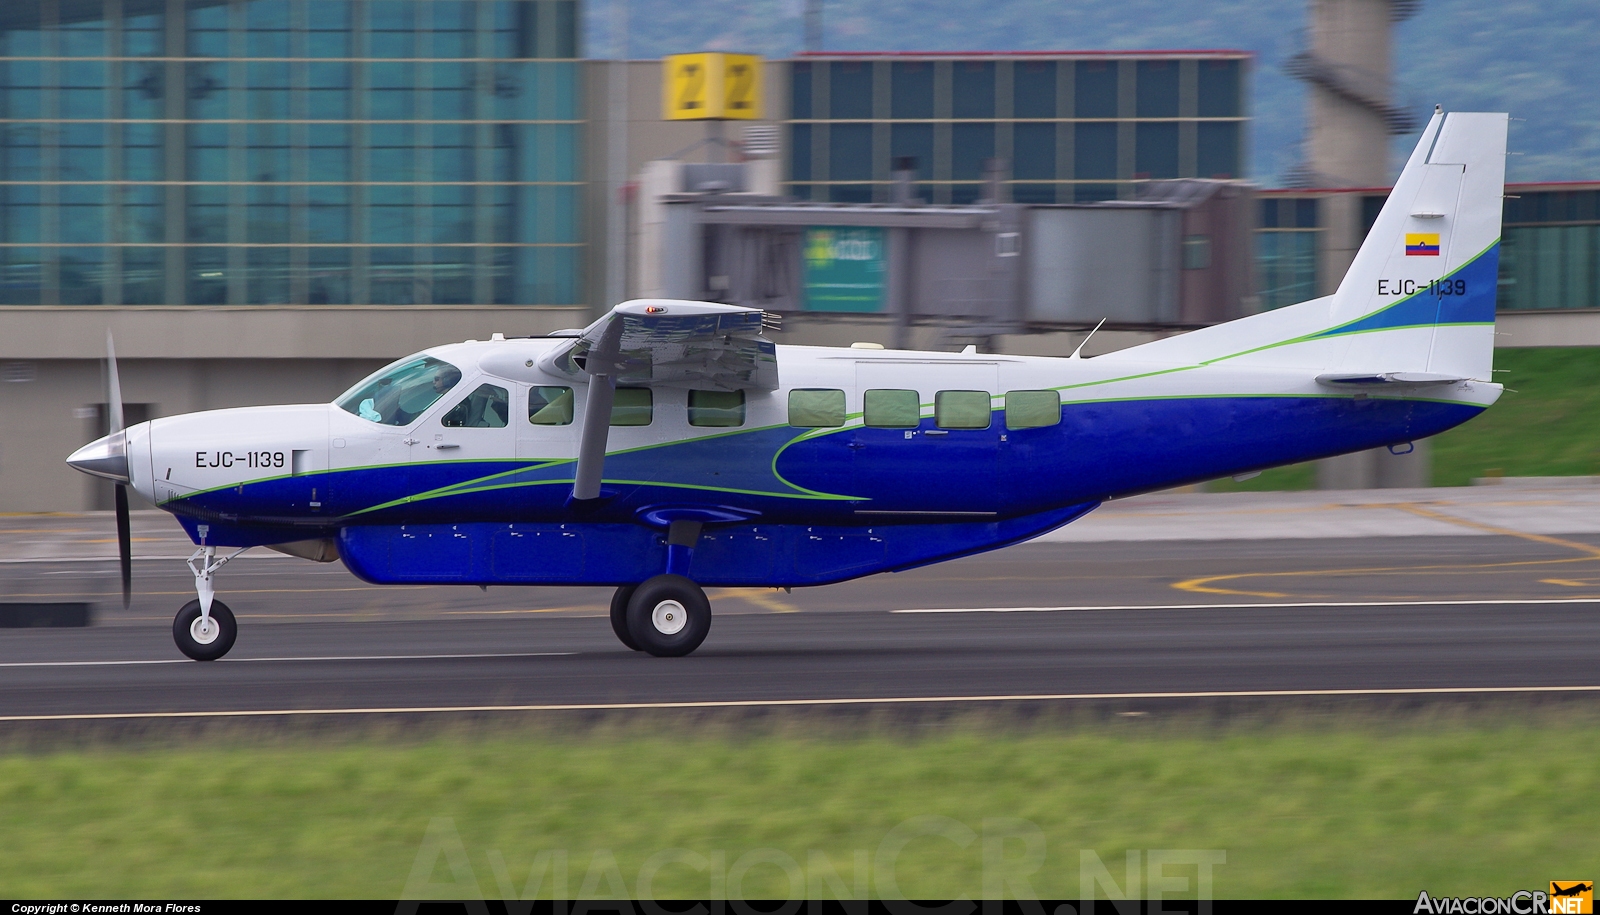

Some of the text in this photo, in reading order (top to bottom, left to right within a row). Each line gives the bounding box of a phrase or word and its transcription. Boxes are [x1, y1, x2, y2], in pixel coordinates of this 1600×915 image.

[676, 64, 705, 110] 2
[725, 64, 756, 110] 2
[1377, 279, 1466, 296] EJC-1139
[195, 451, 285, 468] EJC-1139
